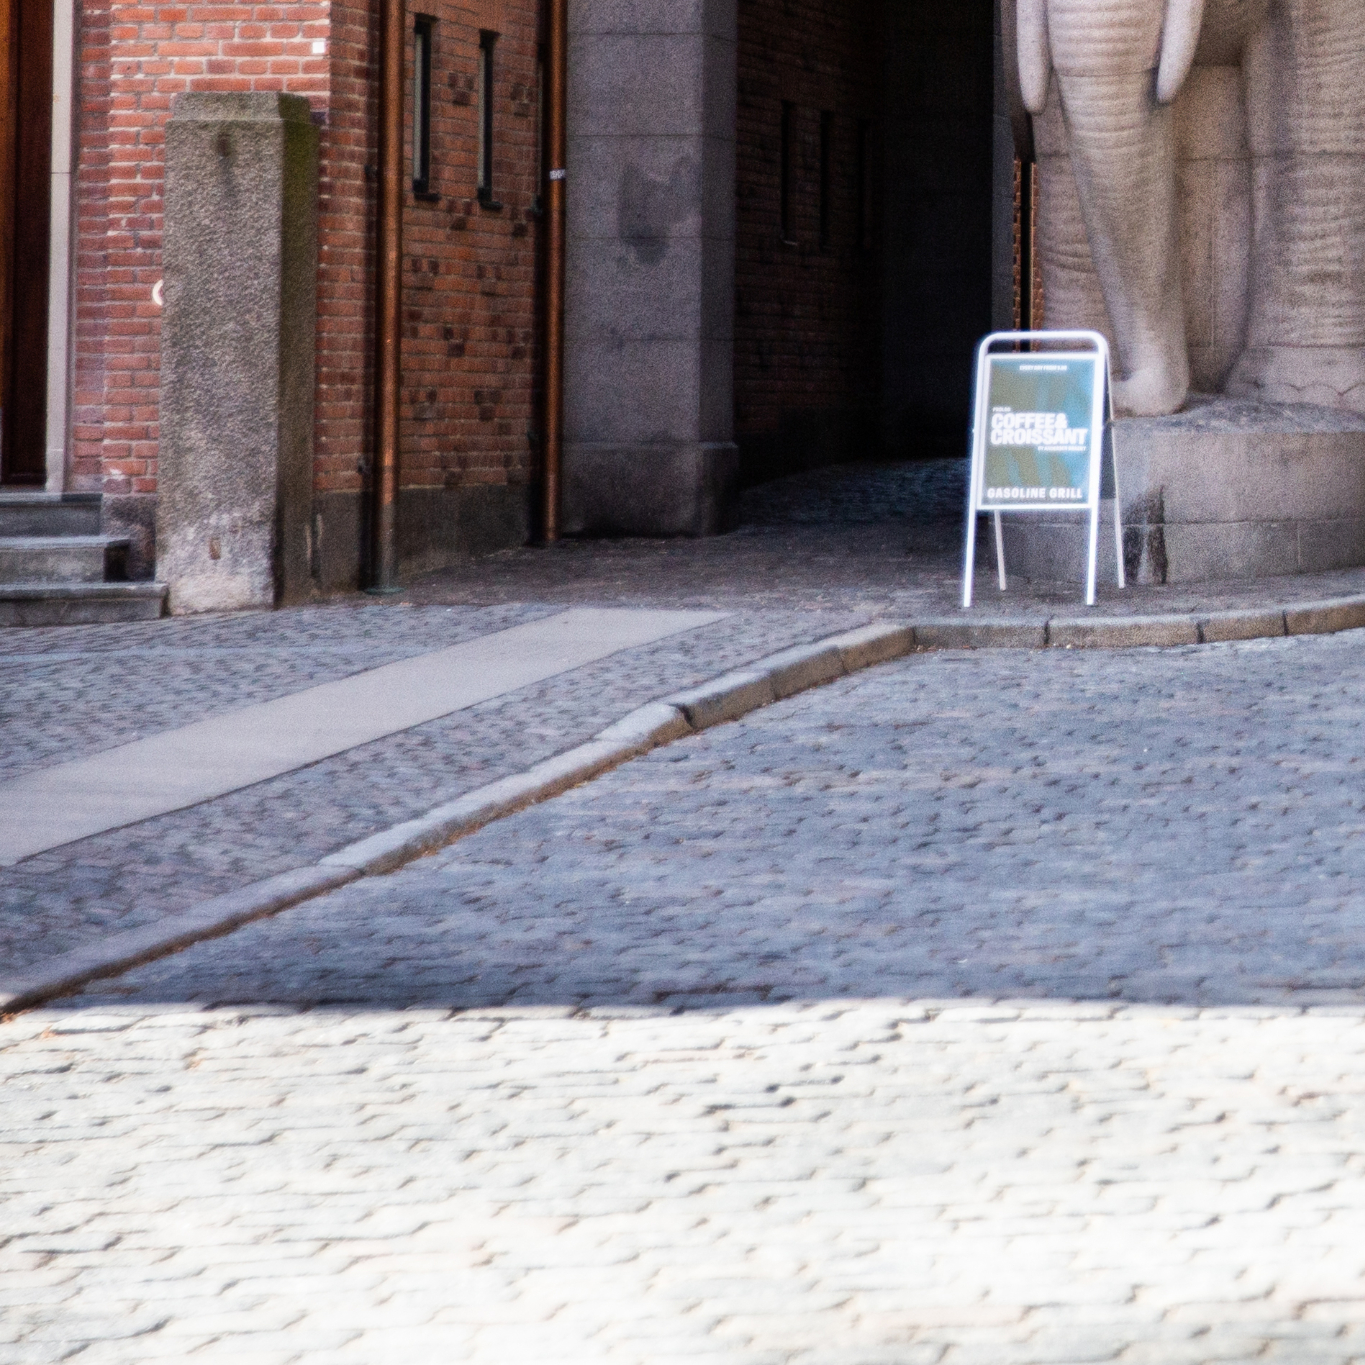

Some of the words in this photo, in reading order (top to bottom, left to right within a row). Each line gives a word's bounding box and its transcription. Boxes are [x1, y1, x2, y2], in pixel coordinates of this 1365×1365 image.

[990, 428, 1088, 445] CROISSANT
[987, 488, 1046, 499] GASOLINE
[1049, 488, 1082, 499] GRILL
